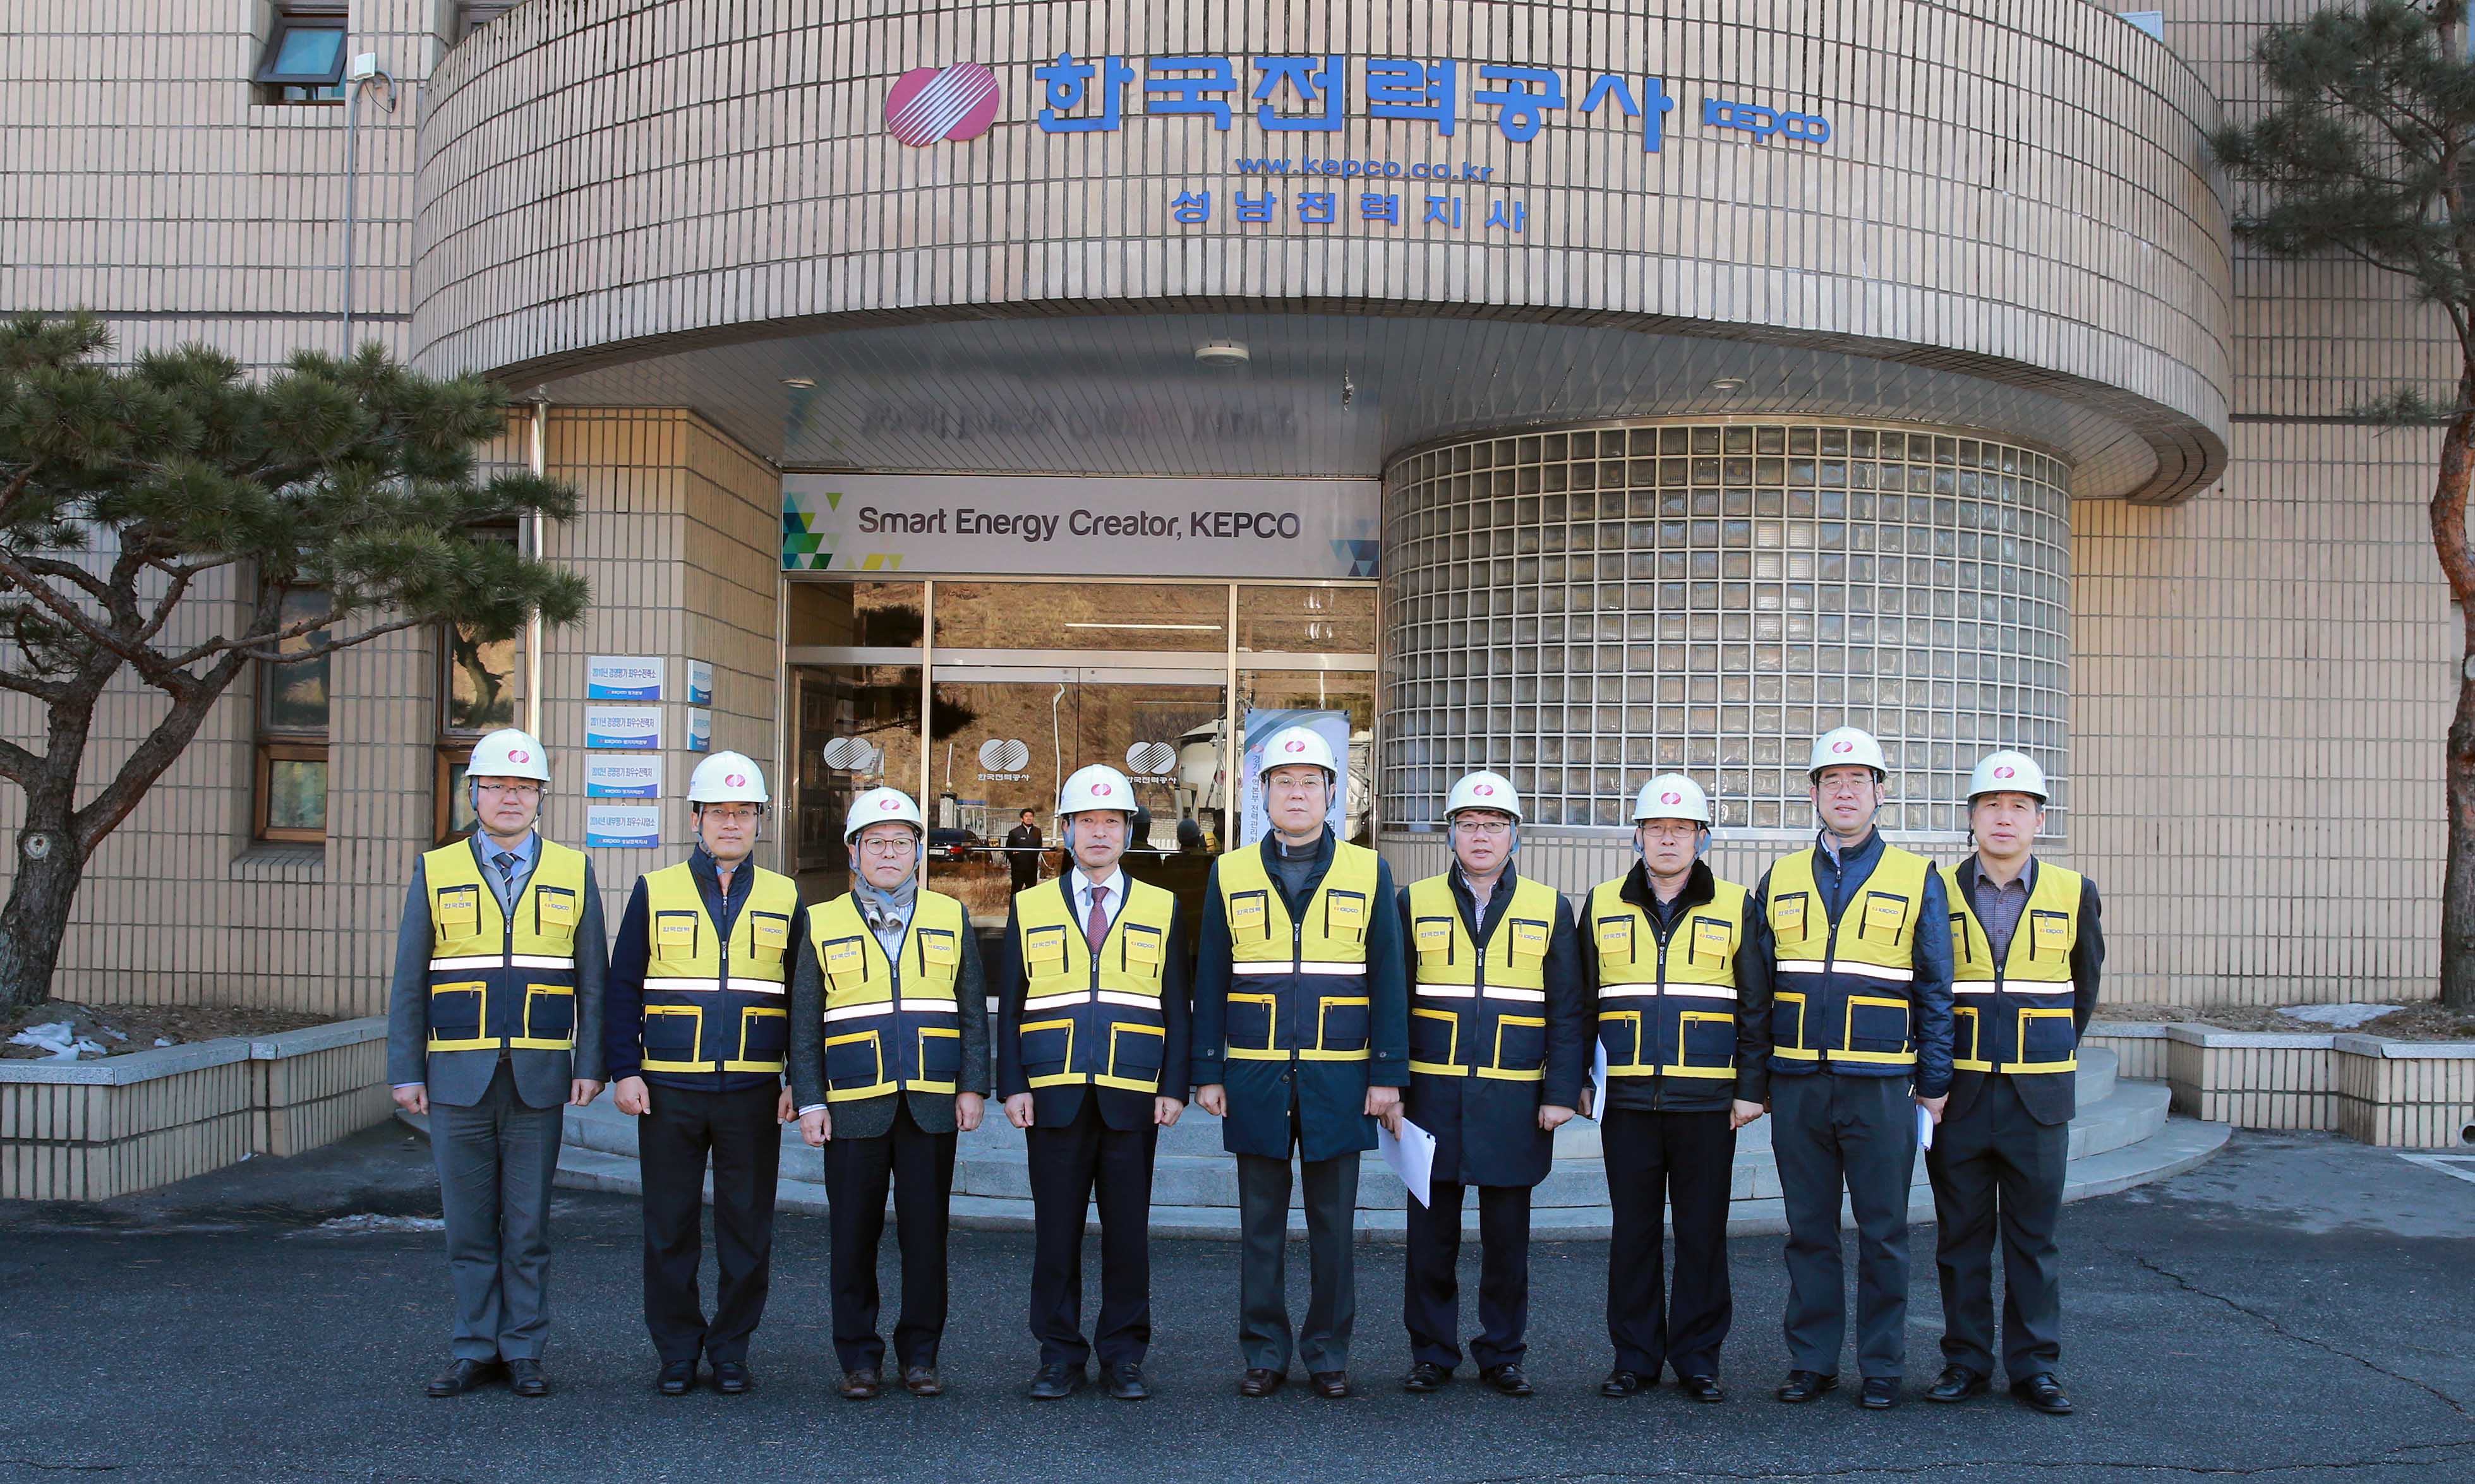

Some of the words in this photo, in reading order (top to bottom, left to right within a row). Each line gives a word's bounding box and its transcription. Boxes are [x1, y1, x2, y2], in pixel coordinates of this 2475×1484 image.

[1035, 51, 1674, 152] 한국전력공사
[1704, 98, 1831, 143] KEPCO
[1236, 155, 1494, 181] ww.kepco.co.kr
[1172, 191, 1527, 232] 성남전력지사
[858, 506, 947, 534] Smart
[956, 508, 1060, 542] Energy
[1069, 509, 1182, 541] Creator,
[1190, 511, 1300, 539] KEPCO
[977, 773, 1031, 782] 한국전력공사
